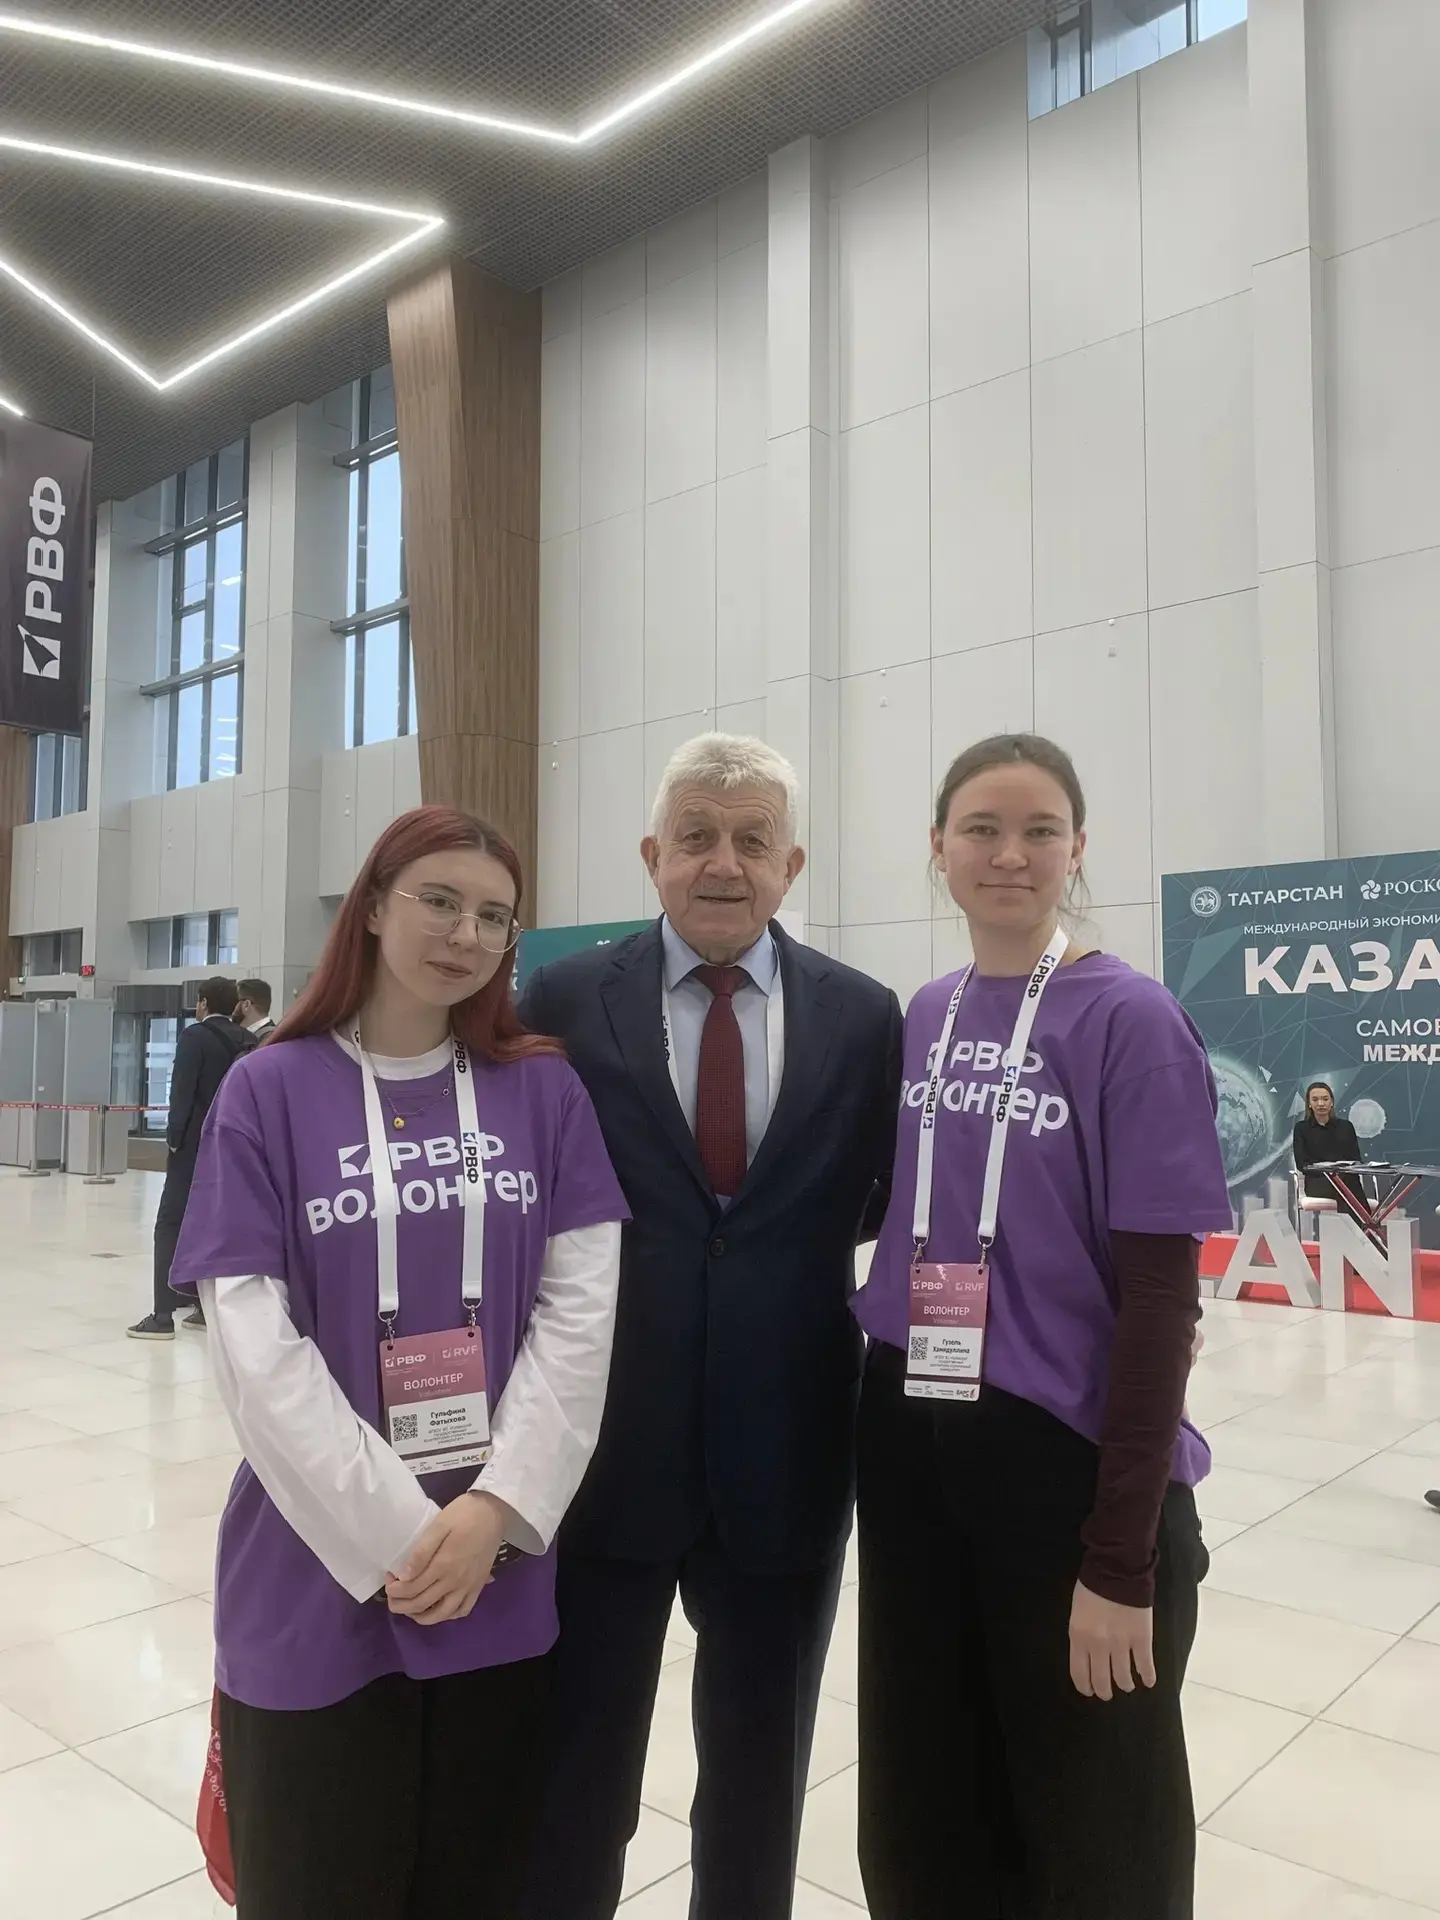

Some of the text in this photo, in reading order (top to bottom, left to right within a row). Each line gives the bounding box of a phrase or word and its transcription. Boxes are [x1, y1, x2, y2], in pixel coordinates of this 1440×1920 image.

[24, 476, 66, 624] РВФ
[1228, 885, 1344, 907] ТАТАРСТАН
[1243, 916, 1369, 935] МЕЖДУНАРОДНЫЙ
[1244, 938, 1440, 995] КАЗА
[1028, 965, 1050, 998] РВФ
[454, 1040, 467, 1073] РВФ
[1363, 1044, 1440, 1066] МЕЖД
[925, 1075, 937, 1114] РВФ
[996, 1082, 1014, 1122] РВФ
[464, 1146, 479, 1184] РВФ
[921, 1281, 943, 1291] РВФ
[964, 1282, 985, 1292] RVF
[924, 1306, 970, 1316] ВОЛОНТЕР
[396, 1353, 427, 1366] РВФ
[453, 1345, 478, 1357] RVF
[404, 1372, 464, 1391] ВОЛОНТЕР
[430, 1415, 466, 1426] Фатыхова
